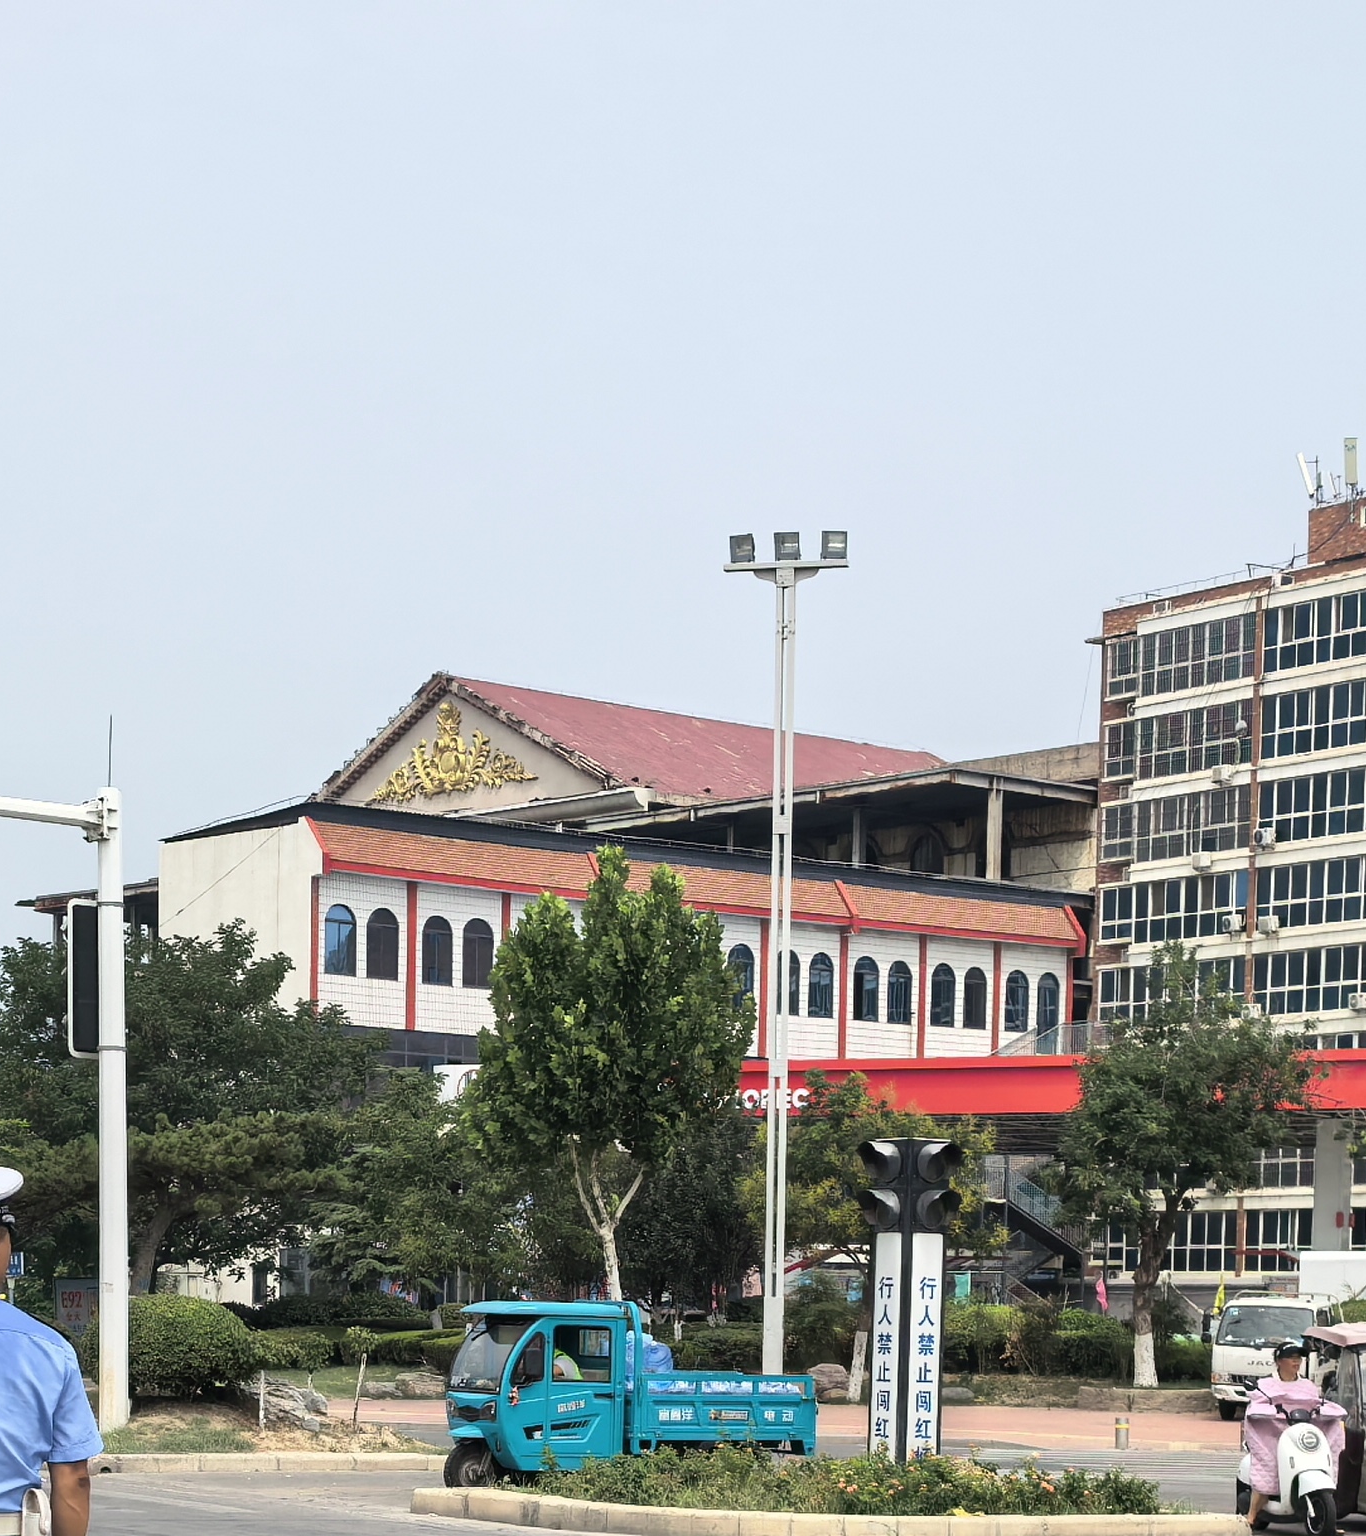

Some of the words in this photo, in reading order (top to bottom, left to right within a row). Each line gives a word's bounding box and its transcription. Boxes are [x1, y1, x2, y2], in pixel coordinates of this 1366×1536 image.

[874, 1276, 895, 1439] 行人禁止闯红
